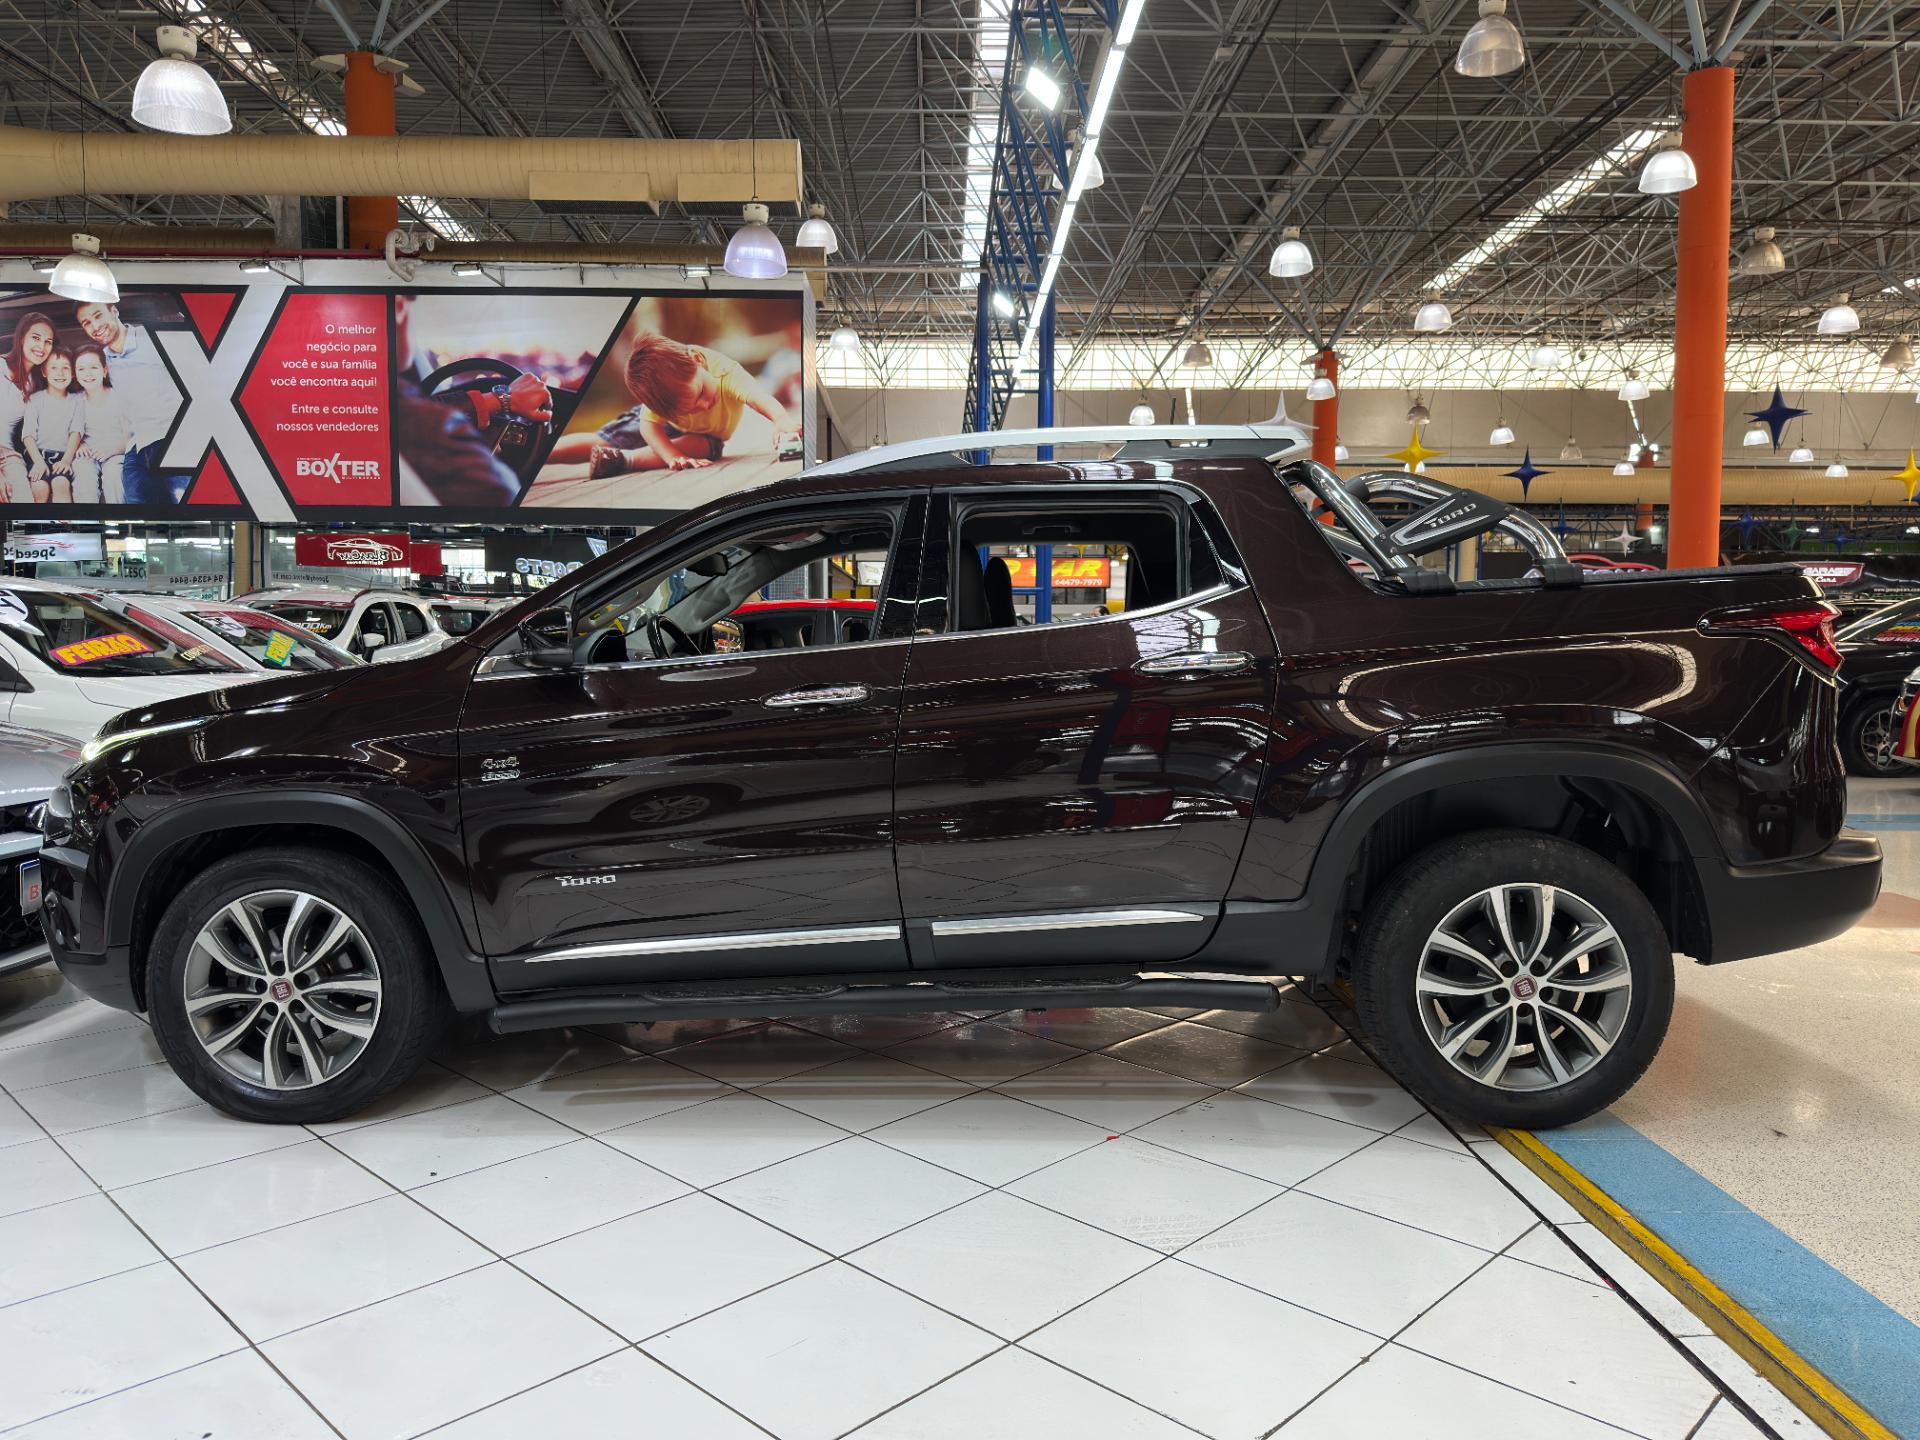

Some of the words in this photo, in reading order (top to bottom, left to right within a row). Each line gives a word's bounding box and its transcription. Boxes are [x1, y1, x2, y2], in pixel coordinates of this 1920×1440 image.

[325, 324, 335, 334] O
[338, 324, 376, 334] melhor
[306, 342, 350, 354] negócio
[353, 344, 377, 354] para
[282, 359, 308, 369] você
[311, 361, 317, 369] e
[320, 361, 338, 369] sua
[342, 359, 377, 369] família
[270, 376, 297, 387] você
[300, 377, 348, 387] encontra
[351, 377, 377, 389] aqui!
[291, 403, 320, 414] Entre
[322, 406, 329, 414] e
[332, 404, 379, 415] consulte
[276, 423, 313, 431] nossos
[316, 421, 379, 432] vendedores
[296, 452, 380, 483] BOXTER
[1423, 502, 1477, 528] TORO
[481, 756, 520, 769] 4x4
[555, 874, 616, 887] TORO
